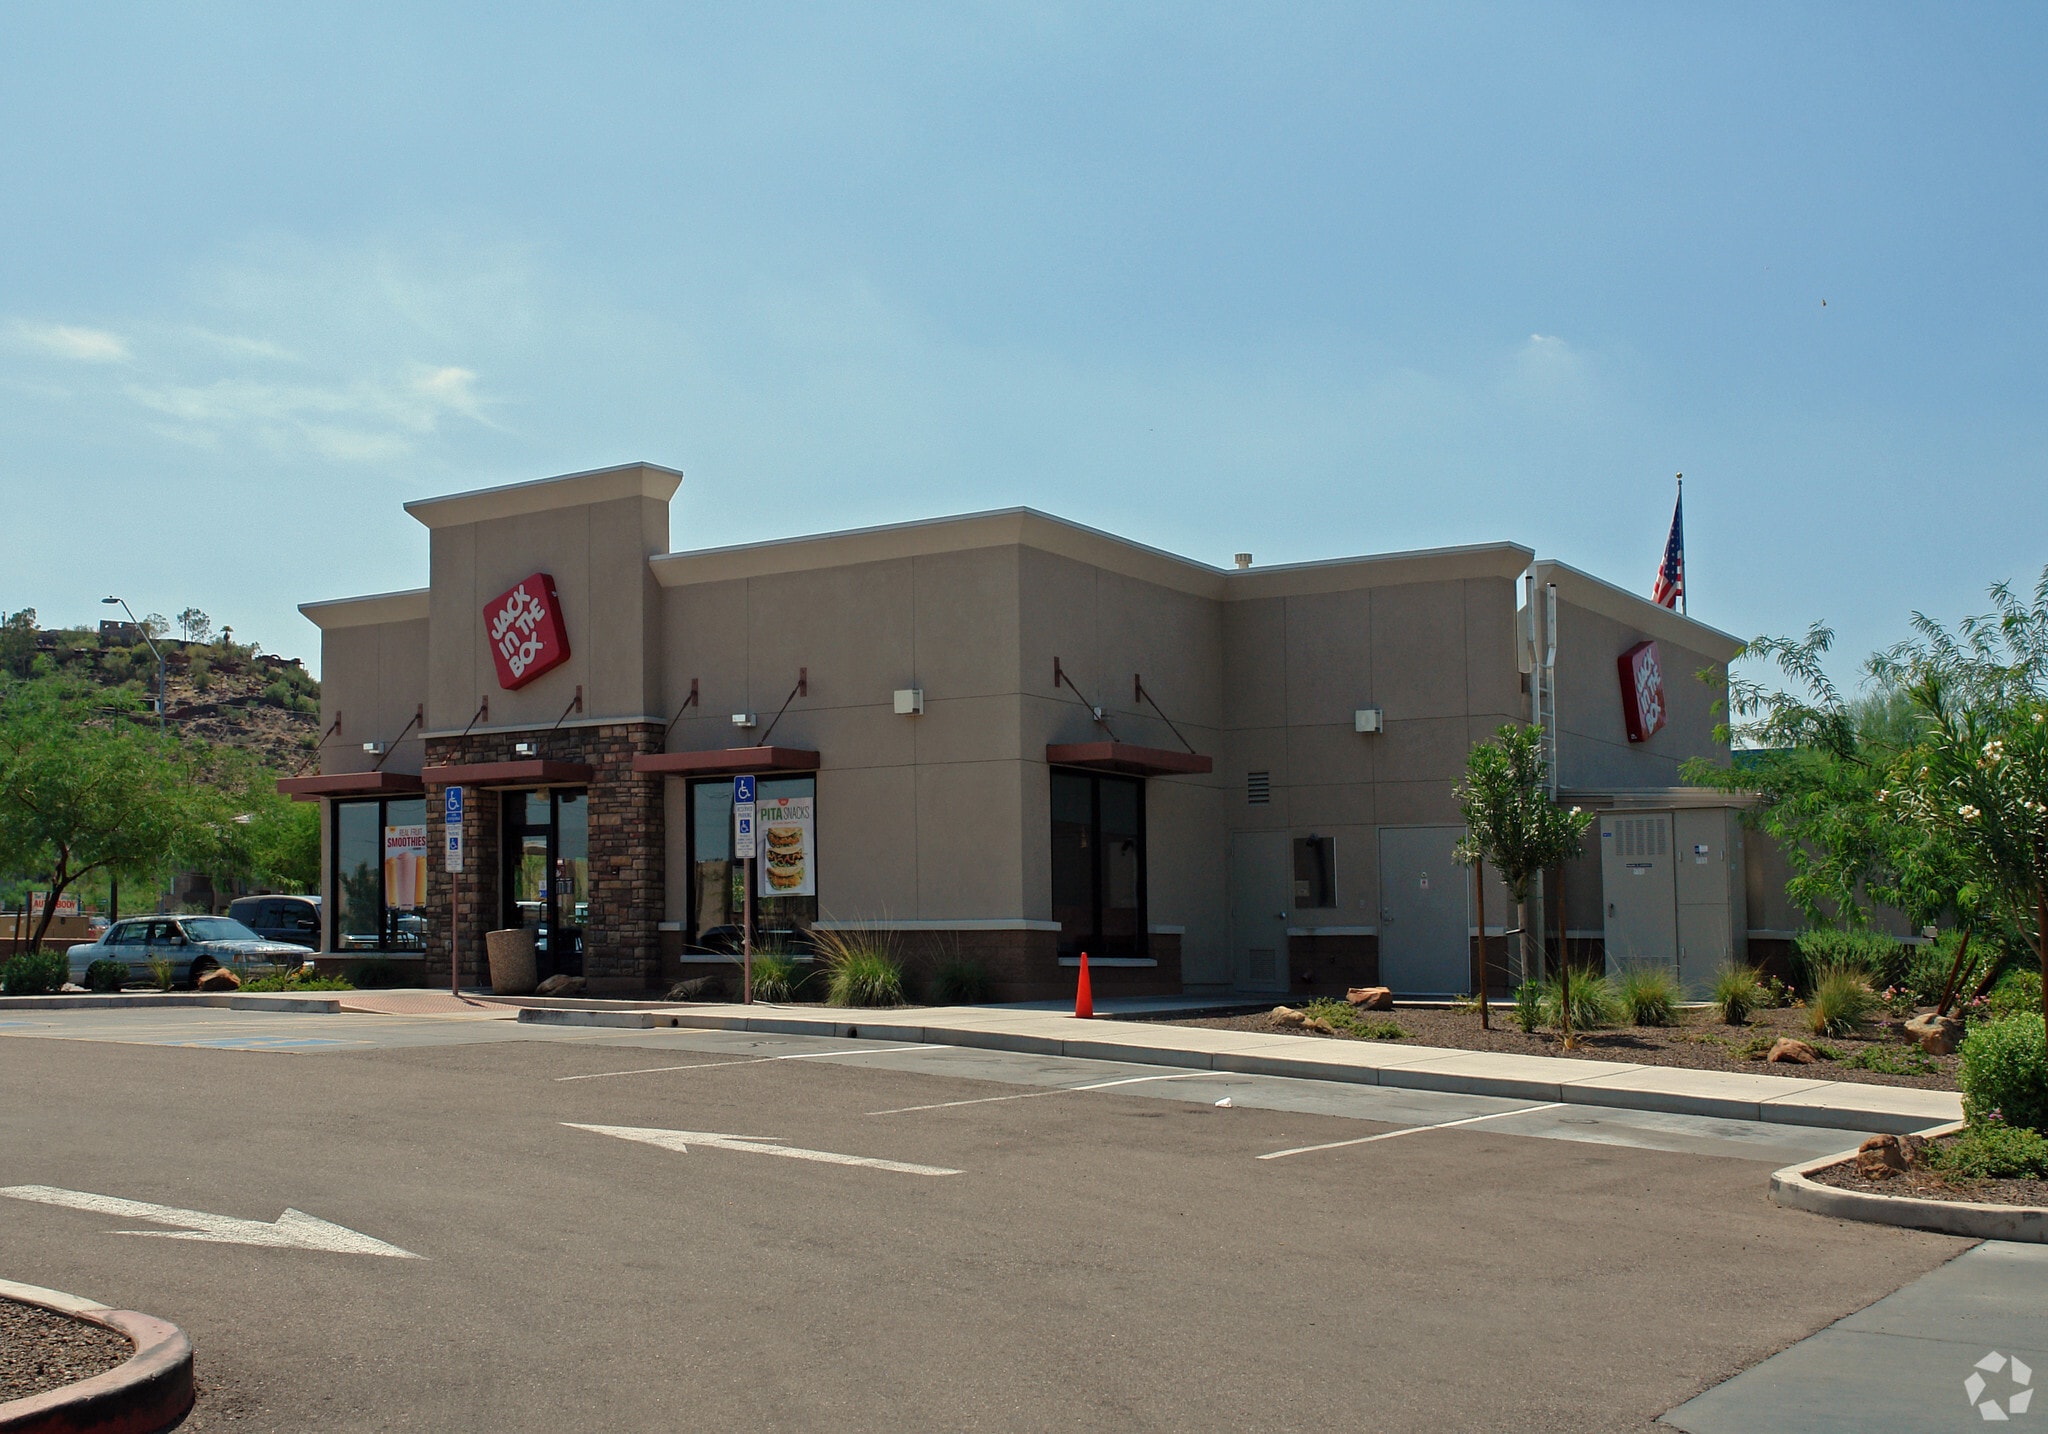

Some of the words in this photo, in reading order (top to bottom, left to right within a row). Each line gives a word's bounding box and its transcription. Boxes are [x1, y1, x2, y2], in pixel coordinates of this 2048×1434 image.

[491, 584, 531, 640] JACK
[515, 597, 546, 636] THE
[508, 631, 544, 678] BOX
[1636, 647, 1655, 693] JACK
[1645, 694, 1662, 735] BOX
[398, 828, 410, 837] REAL
[410, 827, 423, 836] FRUIT
[760, 808, 783, 821] PITA
[783, 805, 810, 820] SNACKS
[387, 836, 426, 848] SMOOTHIES
[55, 900, 76, 909] BODY
